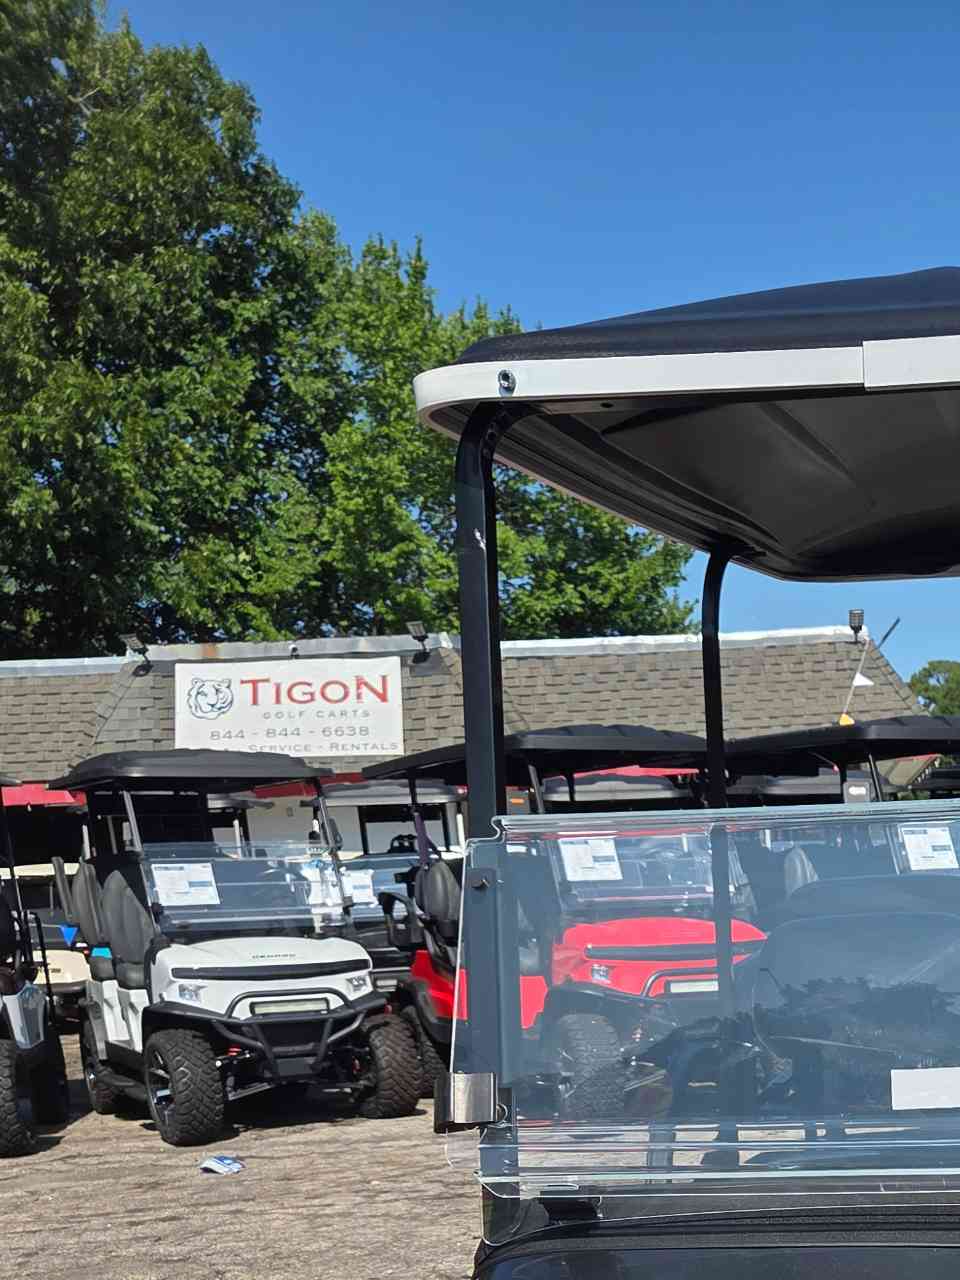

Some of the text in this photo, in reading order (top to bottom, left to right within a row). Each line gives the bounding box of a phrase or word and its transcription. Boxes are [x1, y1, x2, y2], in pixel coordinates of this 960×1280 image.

[240, 674, 390, 706] TIGON
[263, 708, 371, 720] GOLF CARTS
[210, 729, 246, 741] 844
[265, 727, 302, 739] 844
[321, 725, 370, 738] 6638
[247, 743, 312, 753] SERVICE
[329, 741, 399, 752] RENTALS
